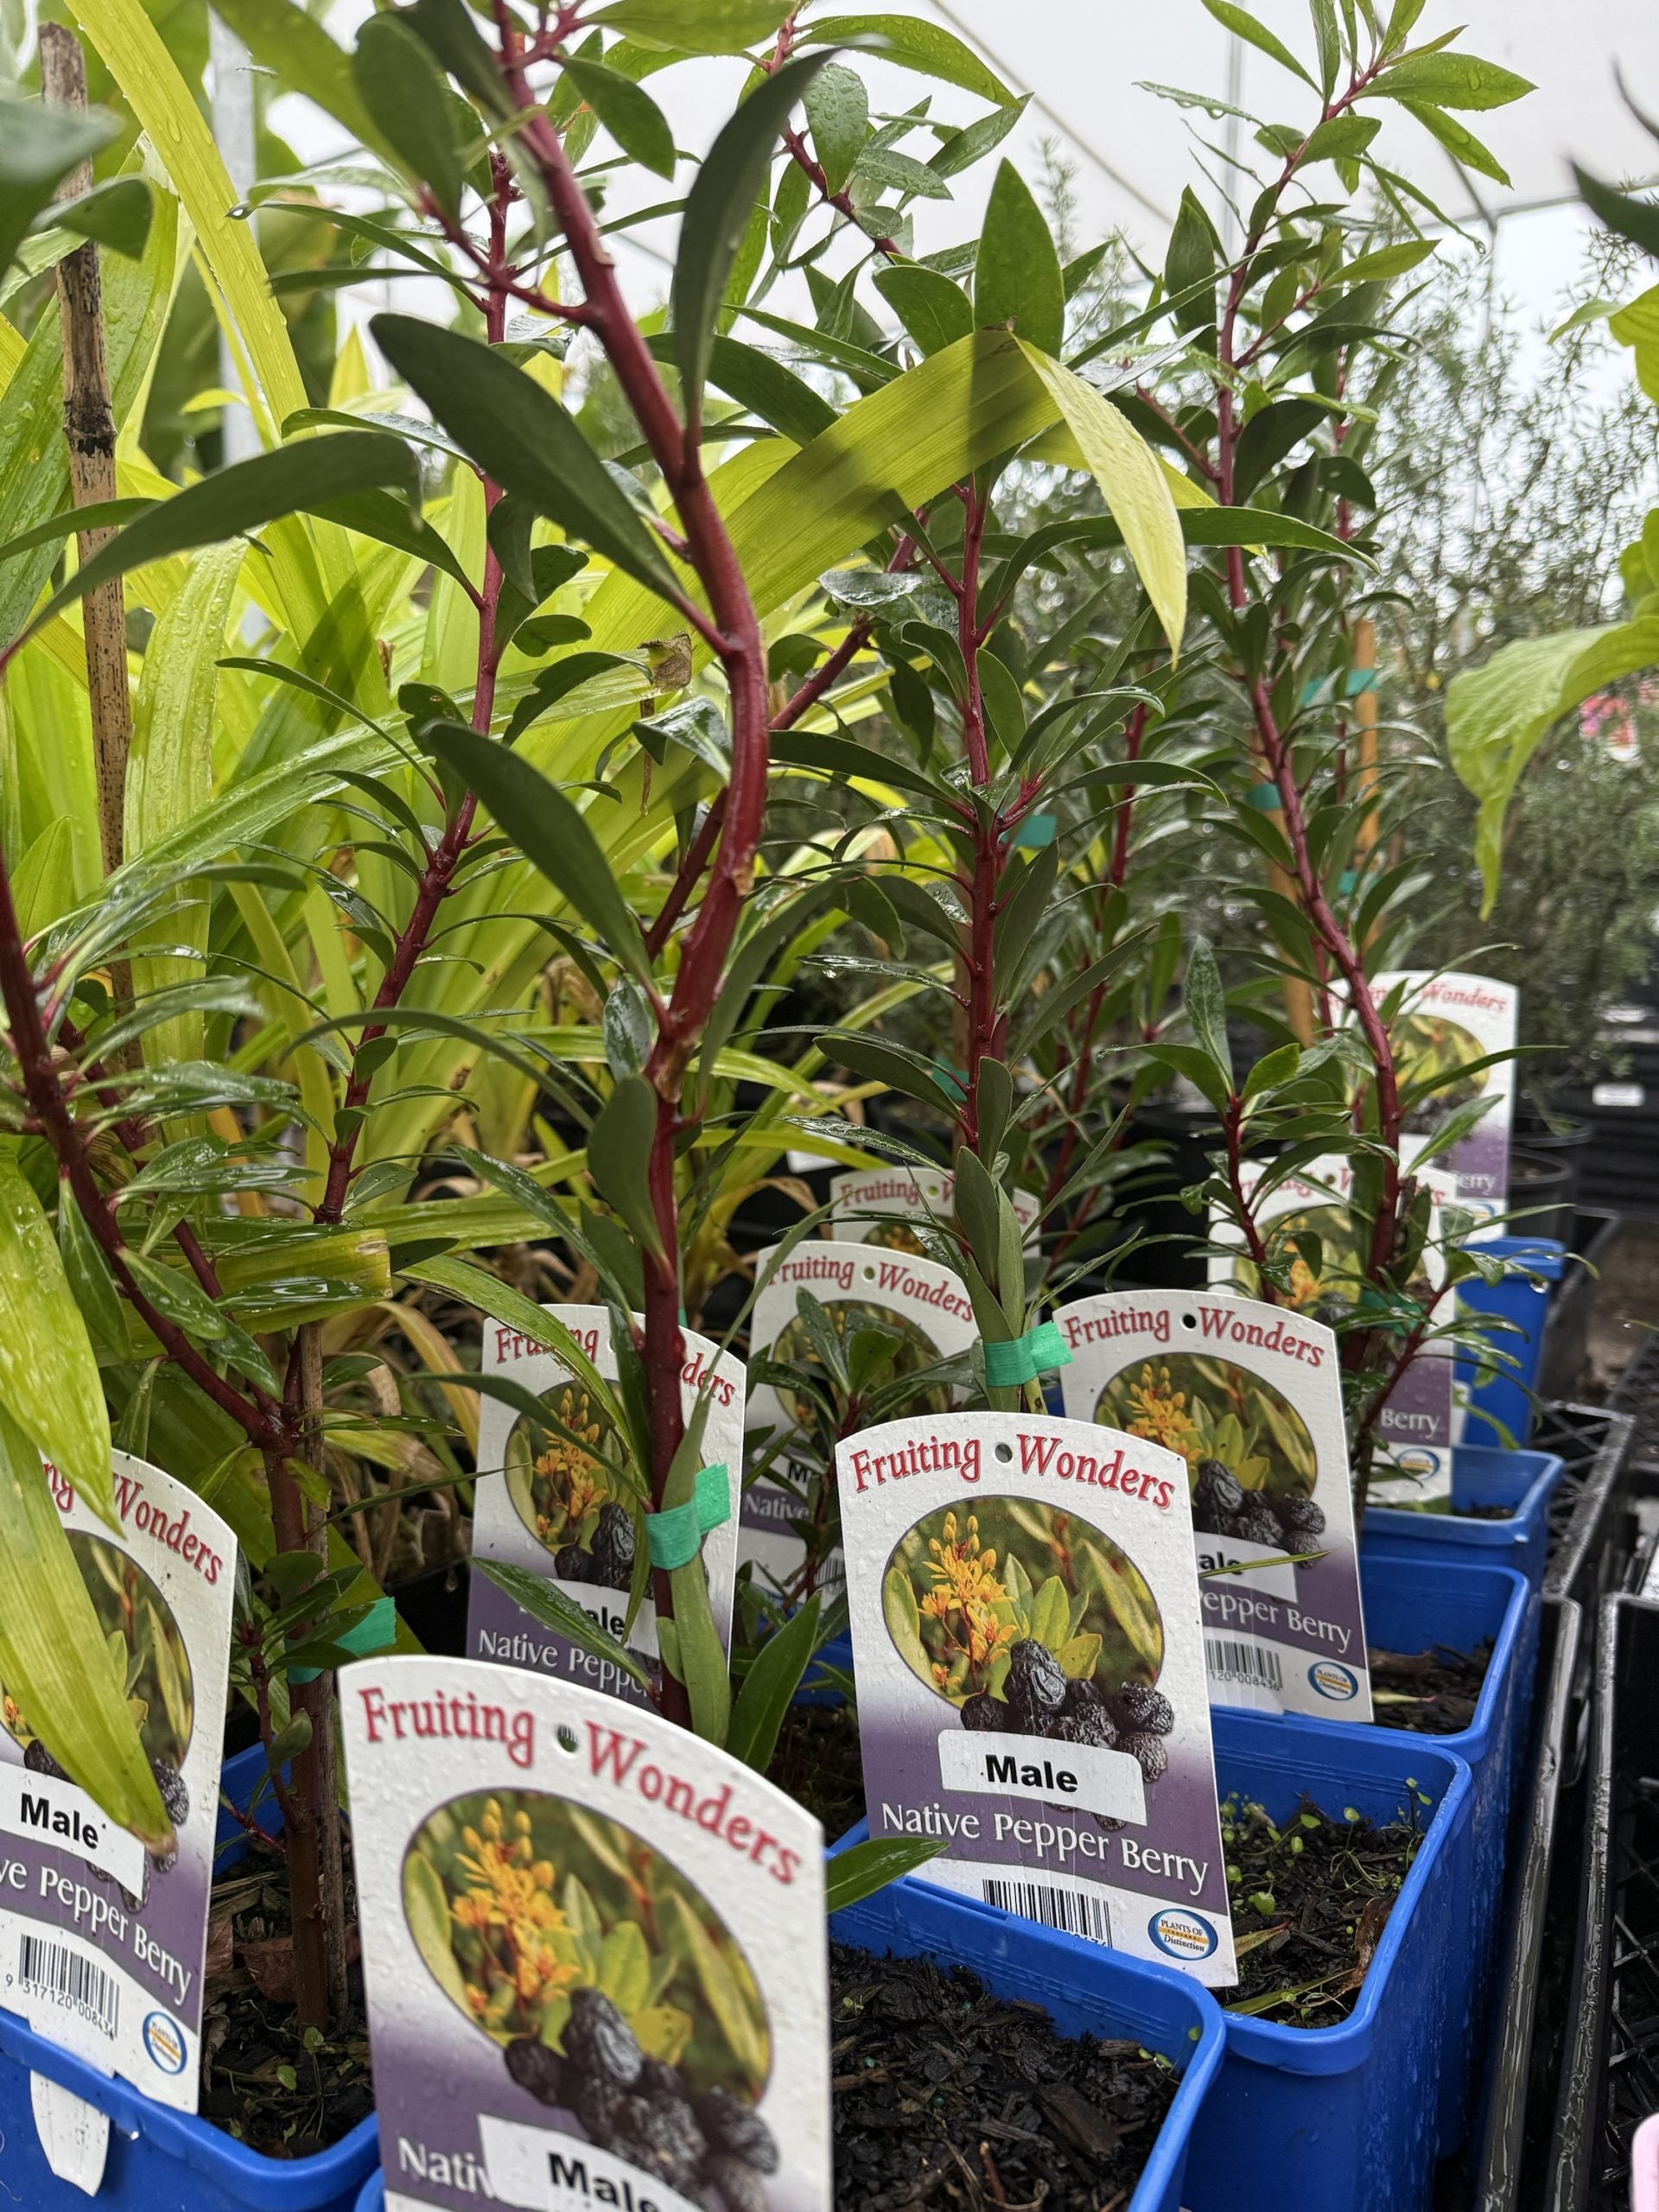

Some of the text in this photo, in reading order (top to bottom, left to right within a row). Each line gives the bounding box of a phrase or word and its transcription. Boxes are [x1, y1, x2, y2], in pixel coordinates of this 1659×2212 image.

[1457, 1175, 1497, 1196] erry
[768, 1255, 973, 1322] ruiting Wonders
[1064, 1306, 1325, 1368] Fruiting Wonders
[1381, 1408, 1441, 1440] Berry
[849, 1433, 1175, 1510] Fruiting Wonders
[113, 1471, 223, 1585] Wonders
[479, 1630, 559, 1668] Native
[1287, 1607, 1351, 1654] Berry
[359, 1688, 801, 1885] Fruiting Wonders
[985, 1754, 1077, 1793] Male
[21, 1792, 99, 1849] Male
[881, 1802, 1208, 1897] Native Pepper Berry
[40, 1866, 129, 1942] Pepper
[134, 1923, 192, 2006] Berry
[1161, 1919, 1203, 1936] PLANTS OF
[1164, 1934, 1205, 1952] Distinction
[23, 1981, 73, 2010] 317120
